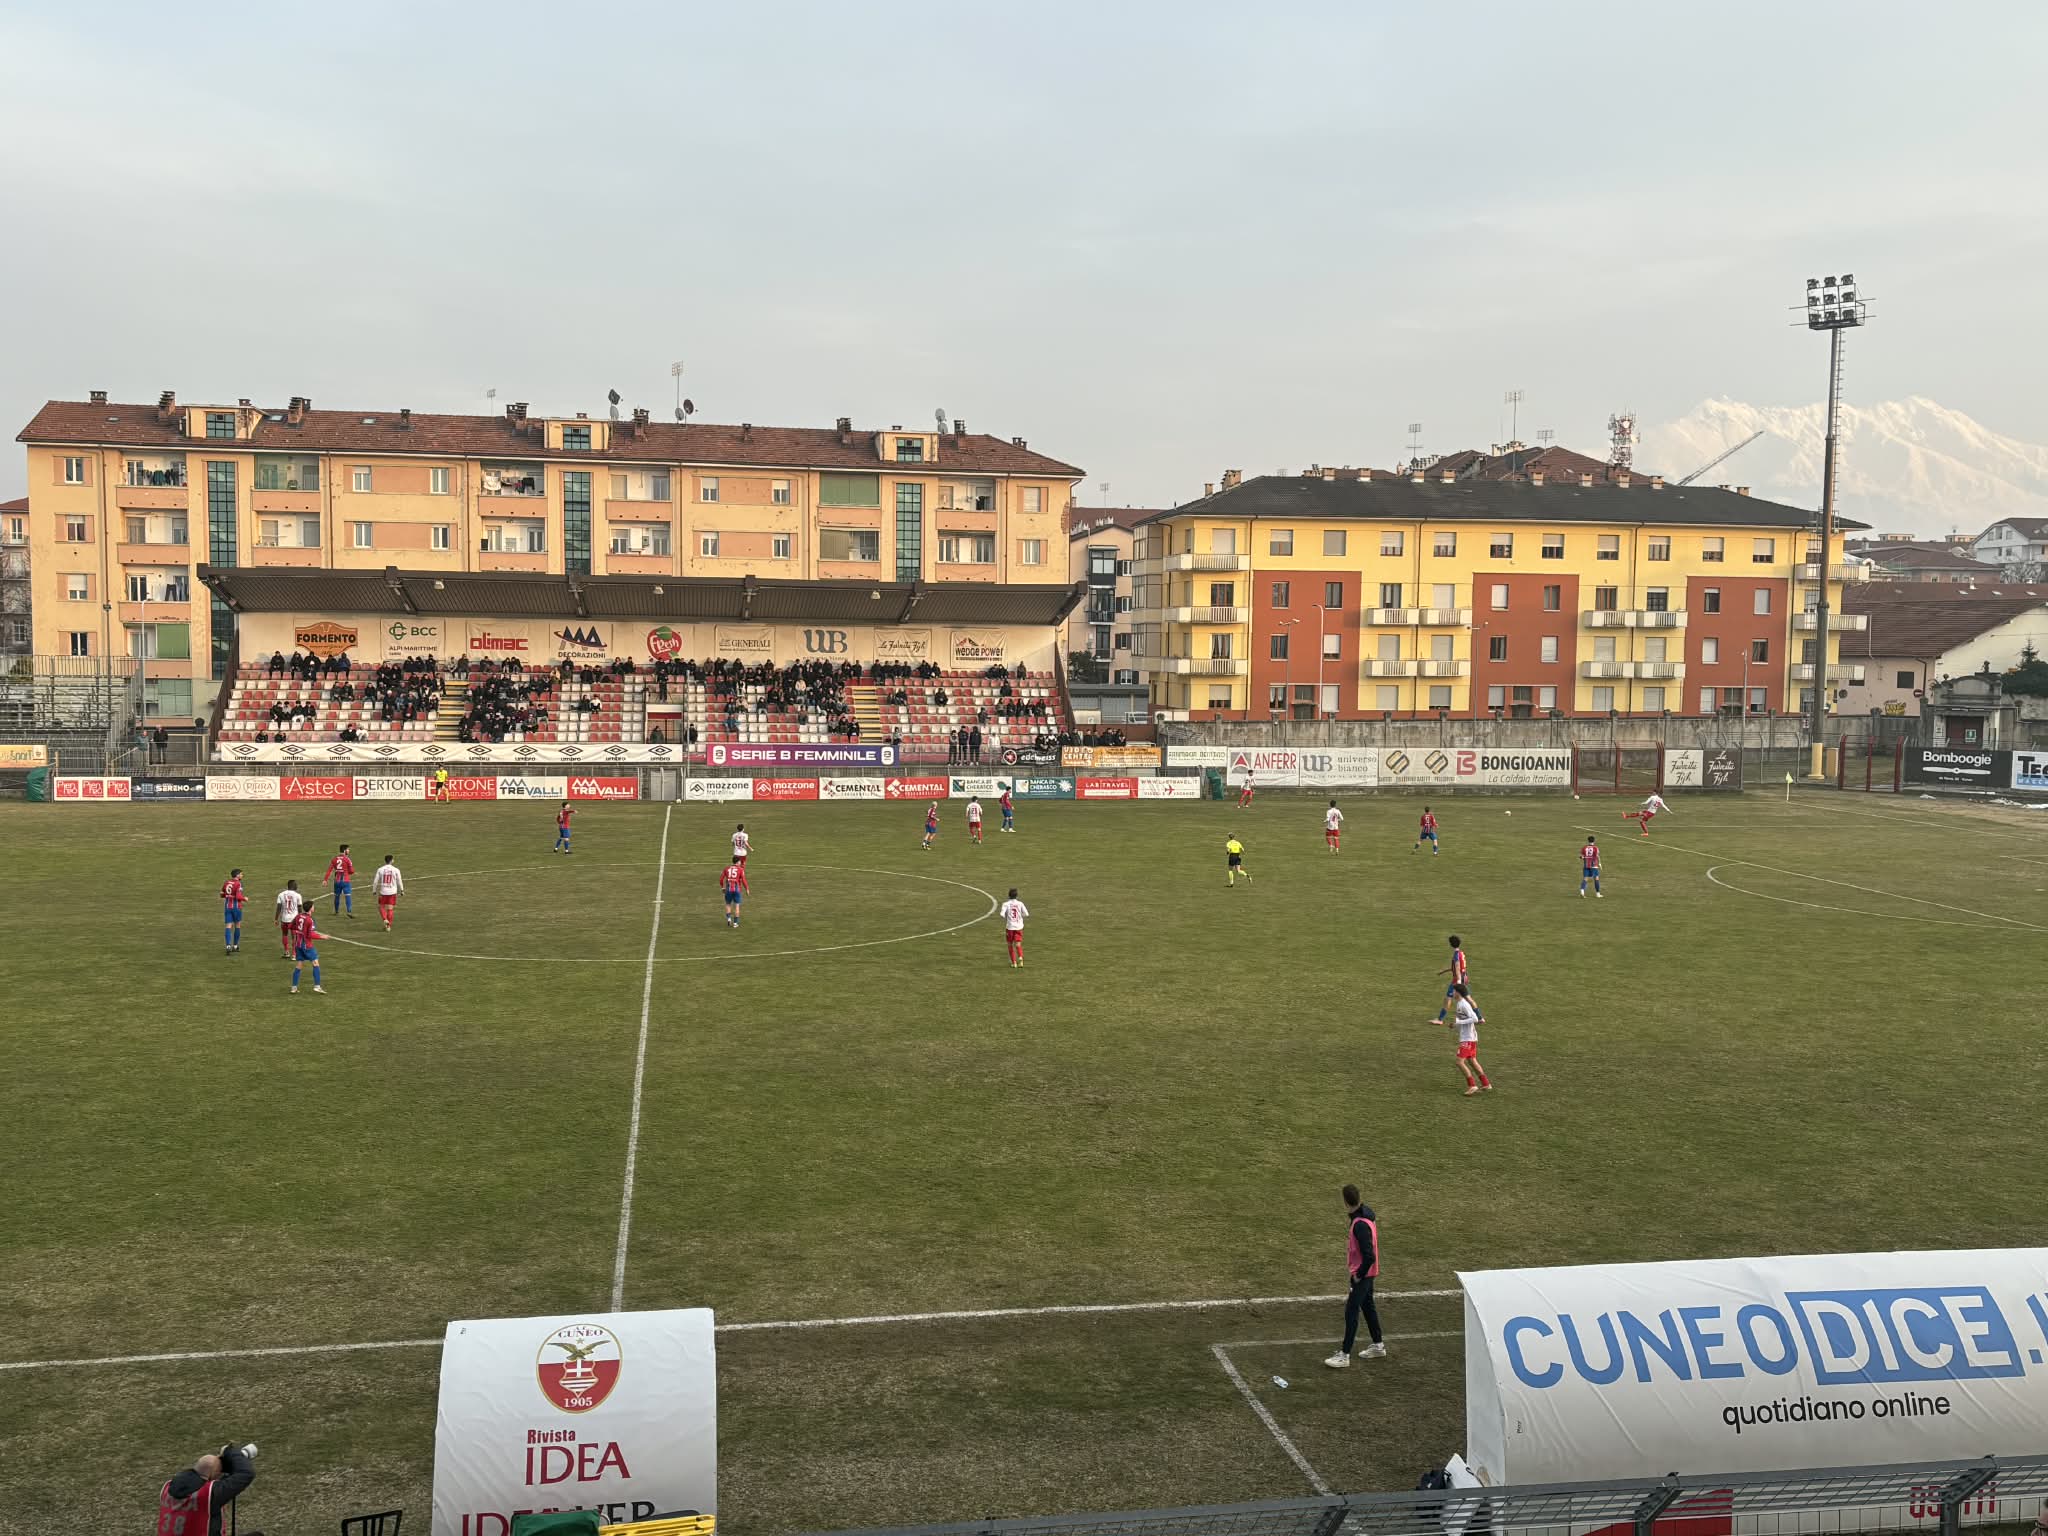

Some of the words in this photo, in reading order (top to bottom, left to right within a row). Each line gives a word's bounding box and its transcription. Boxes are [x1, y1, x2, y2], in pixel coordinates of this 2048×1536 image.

[411, 627, 437, 636] BCC
[296, 634, 356, 643] FORMENTO
[470, 632, 528, 650] olimac
[731, 639, 770, 647] GENERALI
[731, 751, 776, 760] SERIE
[780, 751, 791, 760] B
[795, 751, 876, 761] FEMMINILE
[1253, 752, 1297, 769] ANFERR
[1337, 755, 1377, 763] universo
[1923, 751, 1992, 767] Bomboogie
[1338, 764, 1368, 772] bianco
[1481, 756, 1570, 770] BONGIOANNI
[1488, 774, 1499, 783] La
[1532, 774, 1564, 783] Italiana
[287, 777, 345, 794] Astec
[355, 780, 422, 796] BERTONE
[835, 784, 882, 792] CEMENTAL
[899, 784, 944, 792] CEMENTAL
[500, 787, 562, 795] TREVALLI
[571, 787, 634, 795] TREVALLI
[336, 860, 343, 869] 2
[727, 868, 738, 878] 15
[225, 884, 233, 895] 6
[1011, 908, 1018, 918] 3
[297, 918, 304, 931] 3
[558, 1329, 603, 1339] CUNEO
[563, 1397, 593, 1408] 1905
[1722, 1393, 1865, 1434] quotidiano
[1872, 1392, 1950, 1418] online
[527, 1429, 576, 1444] Rivista
[525, 1441, 632, 1486] IDEA
